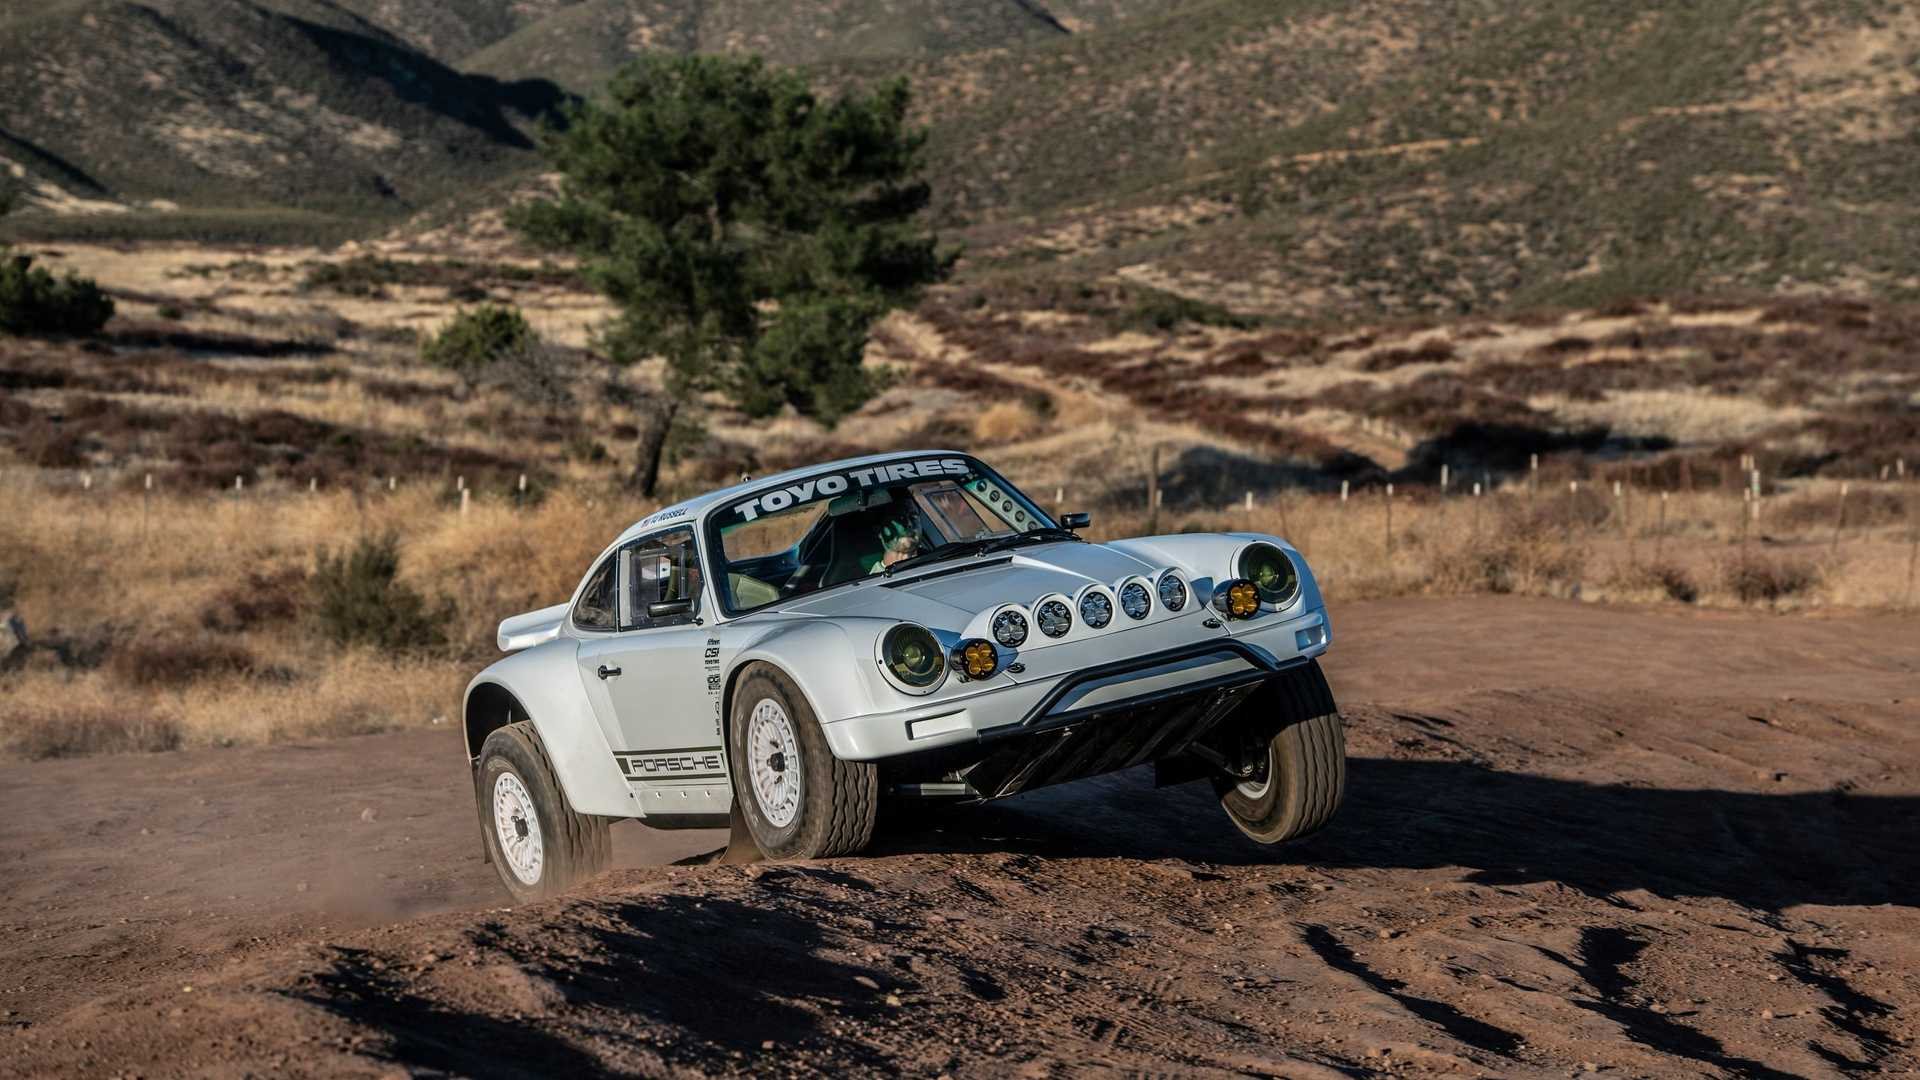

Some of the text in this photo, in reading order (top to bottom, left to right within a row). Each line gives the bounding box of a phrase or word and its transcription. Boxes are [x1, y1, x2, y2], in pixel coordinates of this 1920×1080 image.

[734, 458, 970, 522] TOYO TIRES
[631, 755, 720, 773] PORSCHE
